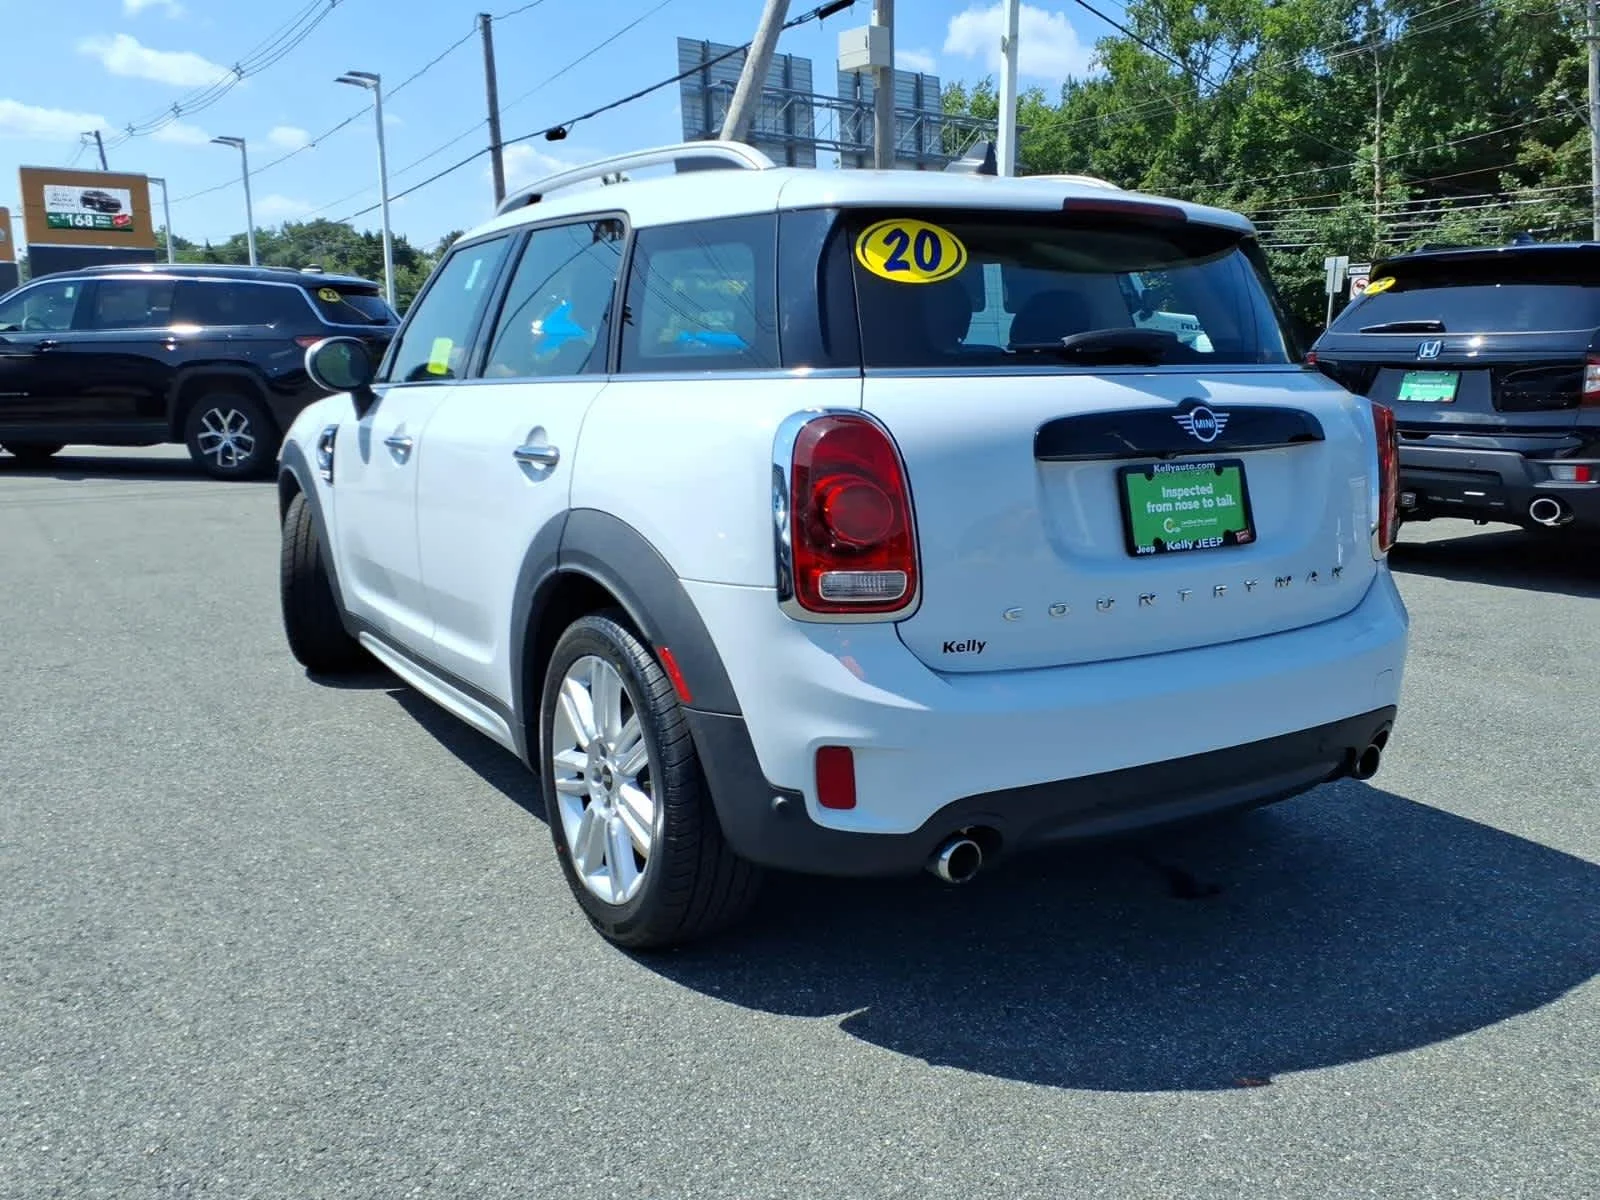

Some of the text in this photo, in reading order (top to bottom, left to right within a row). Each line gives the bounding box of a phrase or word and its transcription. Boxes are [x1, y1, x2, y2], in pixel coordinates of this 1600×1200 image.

[883, 228, 942, 272] 20
[1195, 419, 1215, 429] MINI
[1153, 462, 1216, 473] Kellyauto.com
[1161, 483, 1213, 500] Inspected
[1146, 494, 1236, 513] from nose to tail.
[1136, 545, 1156, 554] Jeep
[1166, 537, 1224, 551] Kelly JEEP
[942, 639, 987, 654] Kelly
